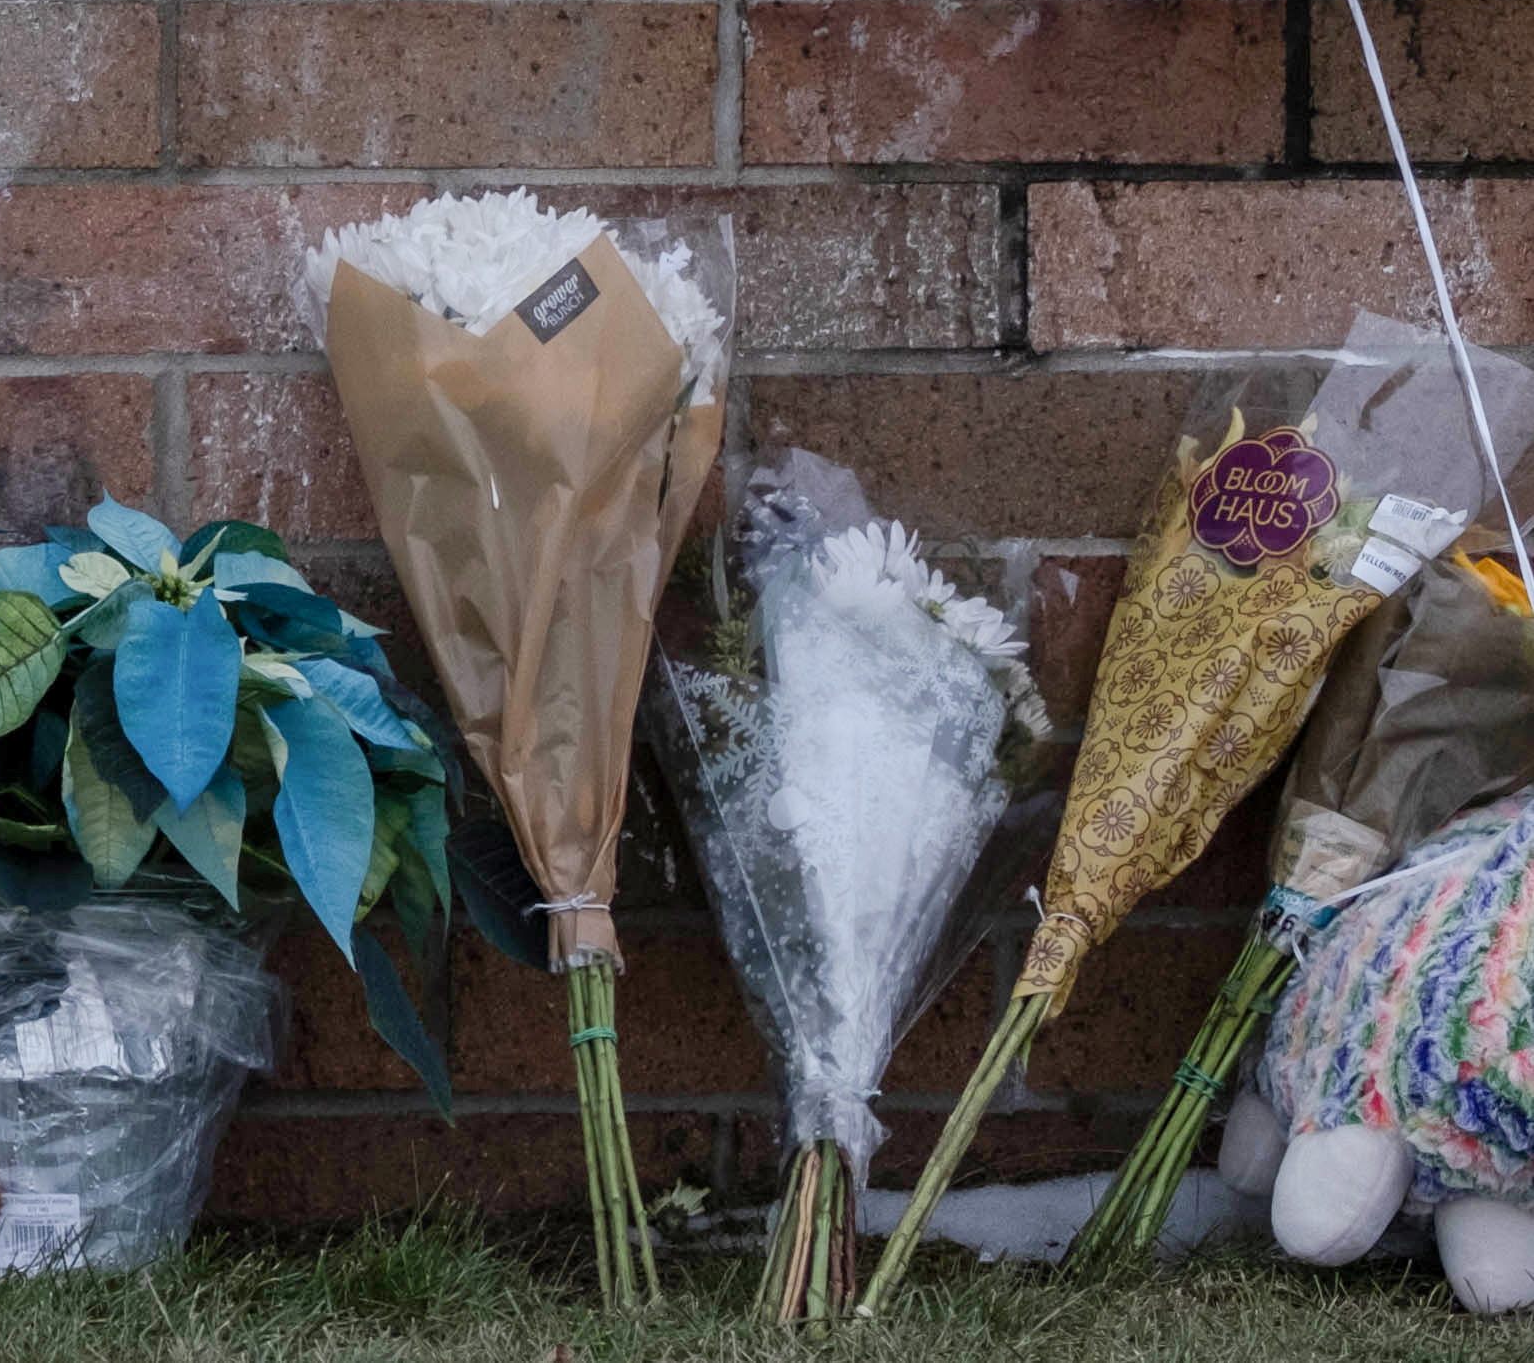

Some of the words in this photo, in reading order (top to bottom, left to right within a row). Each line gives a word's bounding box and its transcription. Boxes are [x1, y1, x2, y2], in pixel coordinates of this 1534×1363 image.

[533, 273, 578, 328] grower
[1224, 467, 1309, 500] BLOOM
[1214, 495, 1297, 529] HAUS
